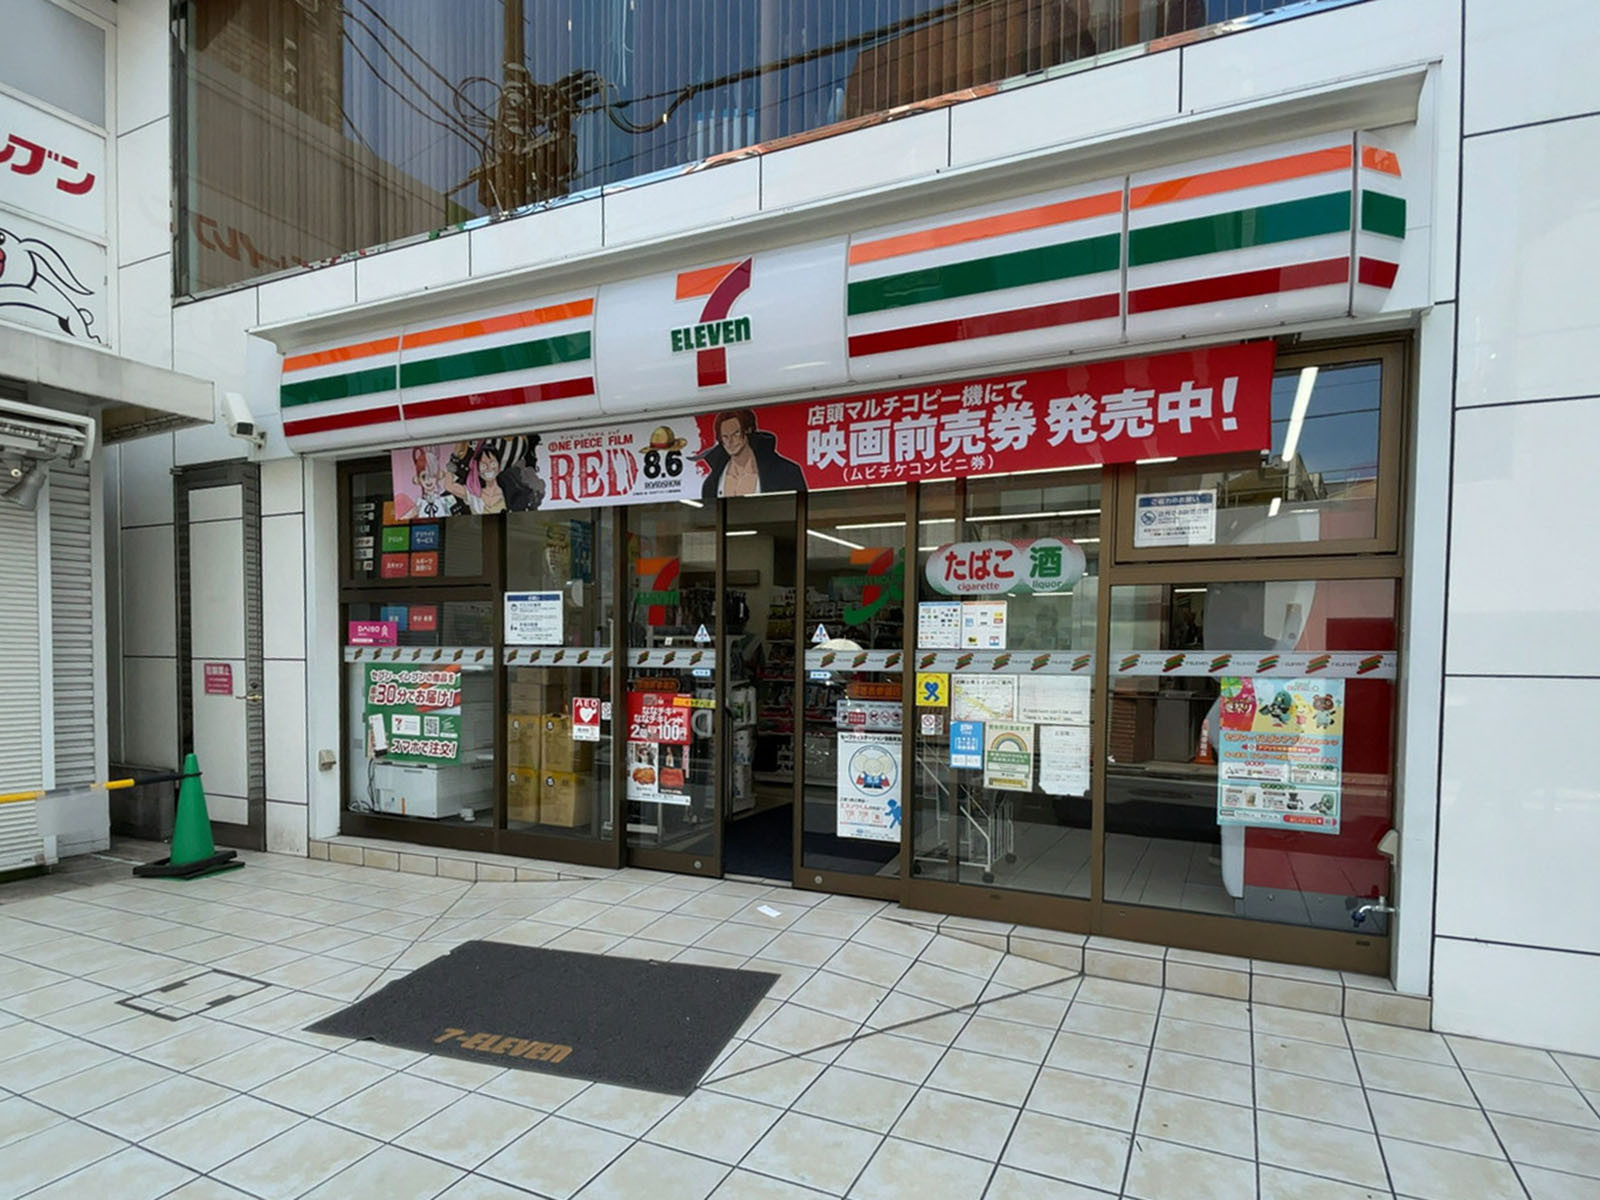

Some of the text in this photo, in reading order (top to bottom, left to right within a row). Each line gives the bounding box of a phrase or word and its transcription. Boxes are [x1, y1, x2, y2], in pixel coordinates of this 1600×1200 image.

[807, 379, 1028, 427] 店頭マルチコピー機にて
[573, 436, 603, 450] PIECE
[608, 433, 634, 446] FILM
[806, 377, 1239, 470] 映画前売券 発売中!
[549, 447, 639, 504] RED
[643, 450, 684, 480] 8.6
[944, 546, 1063, 582] たばこ 酒
[957, 579, 1063, 592] cigarette liquor
